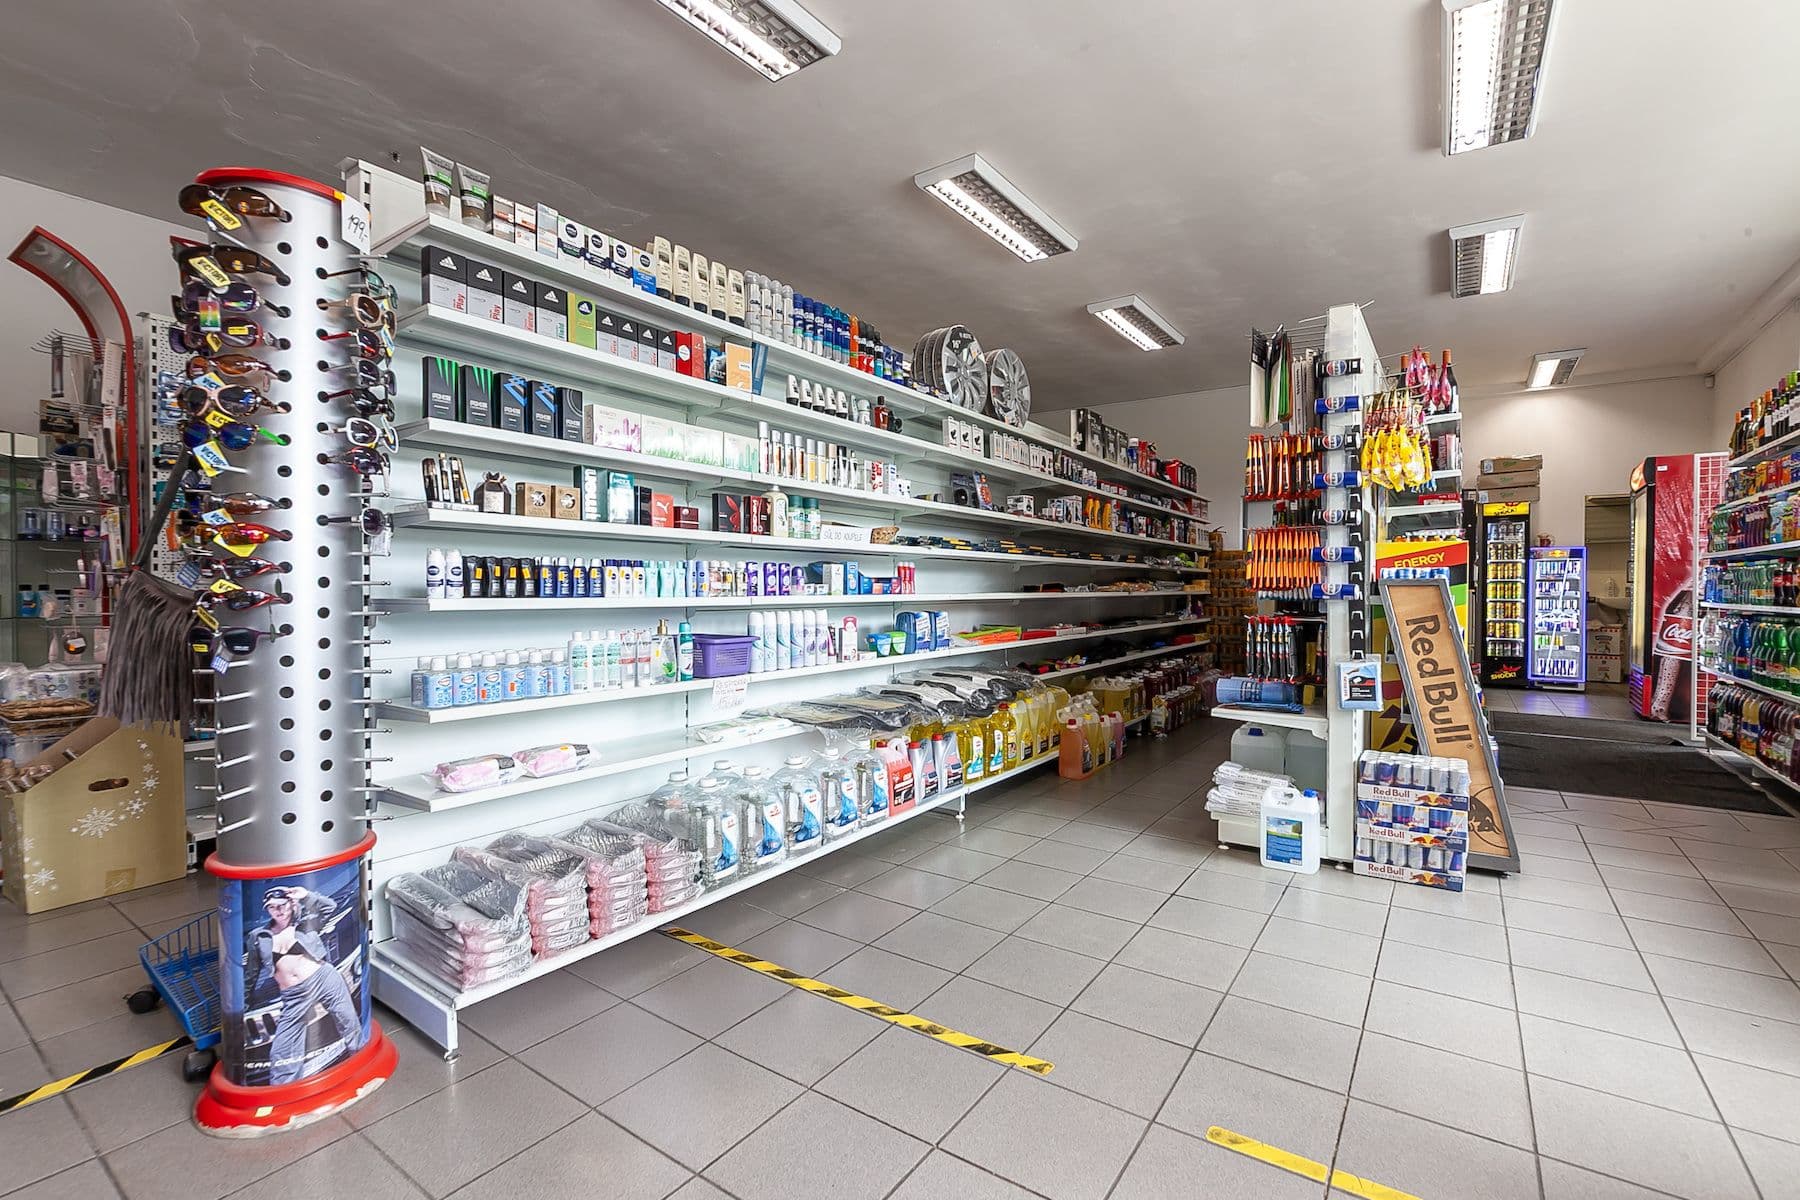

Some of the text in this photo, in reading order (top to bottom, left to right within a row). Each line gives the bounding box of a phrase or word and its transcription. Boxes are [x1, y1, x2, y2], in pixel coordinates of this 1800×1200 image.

[207, 201, 237, 226] VICTORY
[197, 258, 227, 283] VICTORY
[201, 446, 226, 467] VICTOR
[1394, 552, 1445, 569] ENERGY
[1662, 622, 1693, 645] Coca
[1405, 614, 1473, 744] Red Bull
[1373, 786, 1410, 798] Red Bull
[1369, 827, 1405, 839] Red Bull
[1368, 863, 1405, 876] Red Bull
